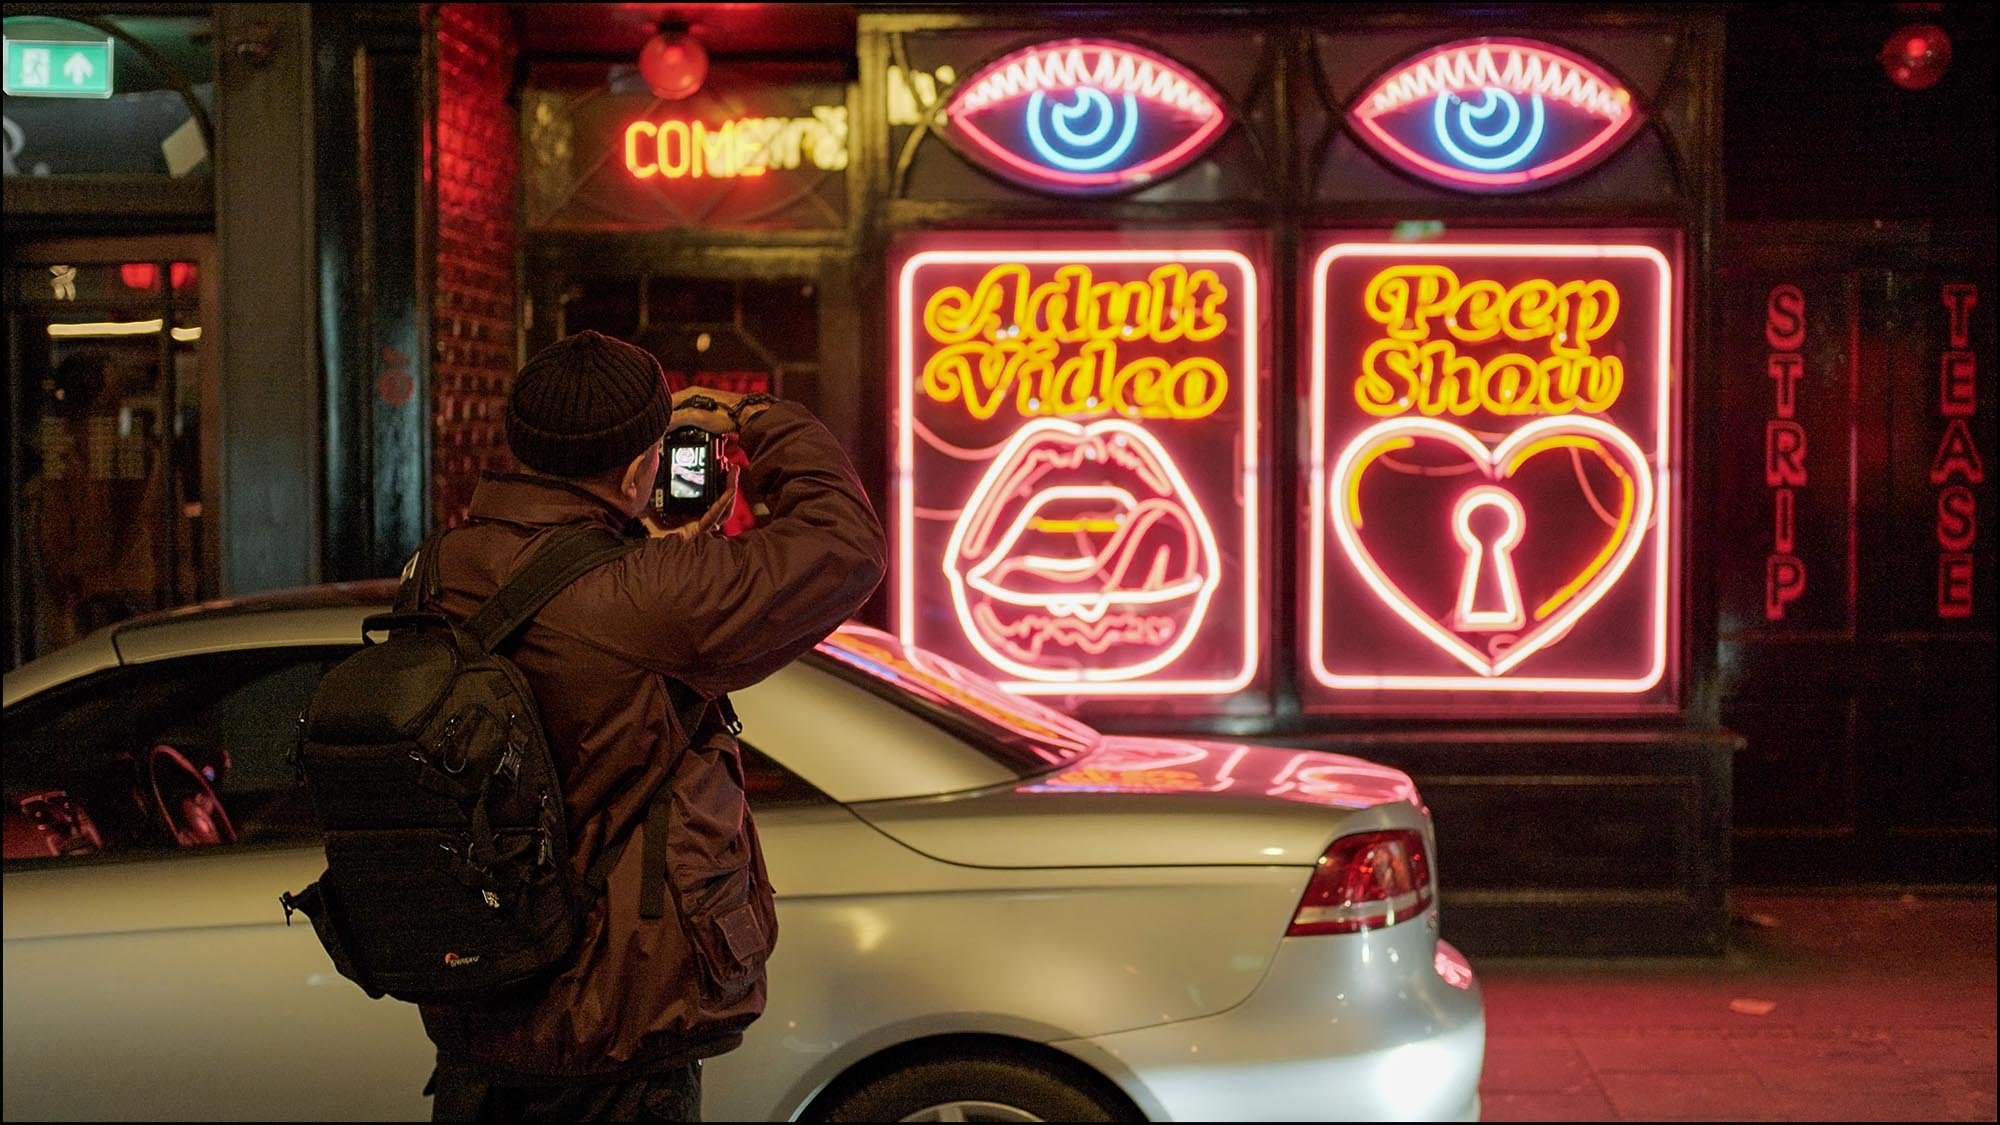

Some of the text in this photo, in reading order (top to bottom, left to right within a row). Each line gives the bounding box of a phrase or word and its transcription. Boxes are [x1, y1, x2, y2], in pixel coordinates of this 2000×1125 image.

[624, 119, 768, 179] COME
[923, 264, 1228, 343] Adult
[1364, 264, 1620, 358] Peep
[923, 340, 1229, 419] Video
[1354, 338, 1624, 417] Show
[1766, 284, 1807, 620] STRIP
[1930, 283, 1985, 619] TEASE
